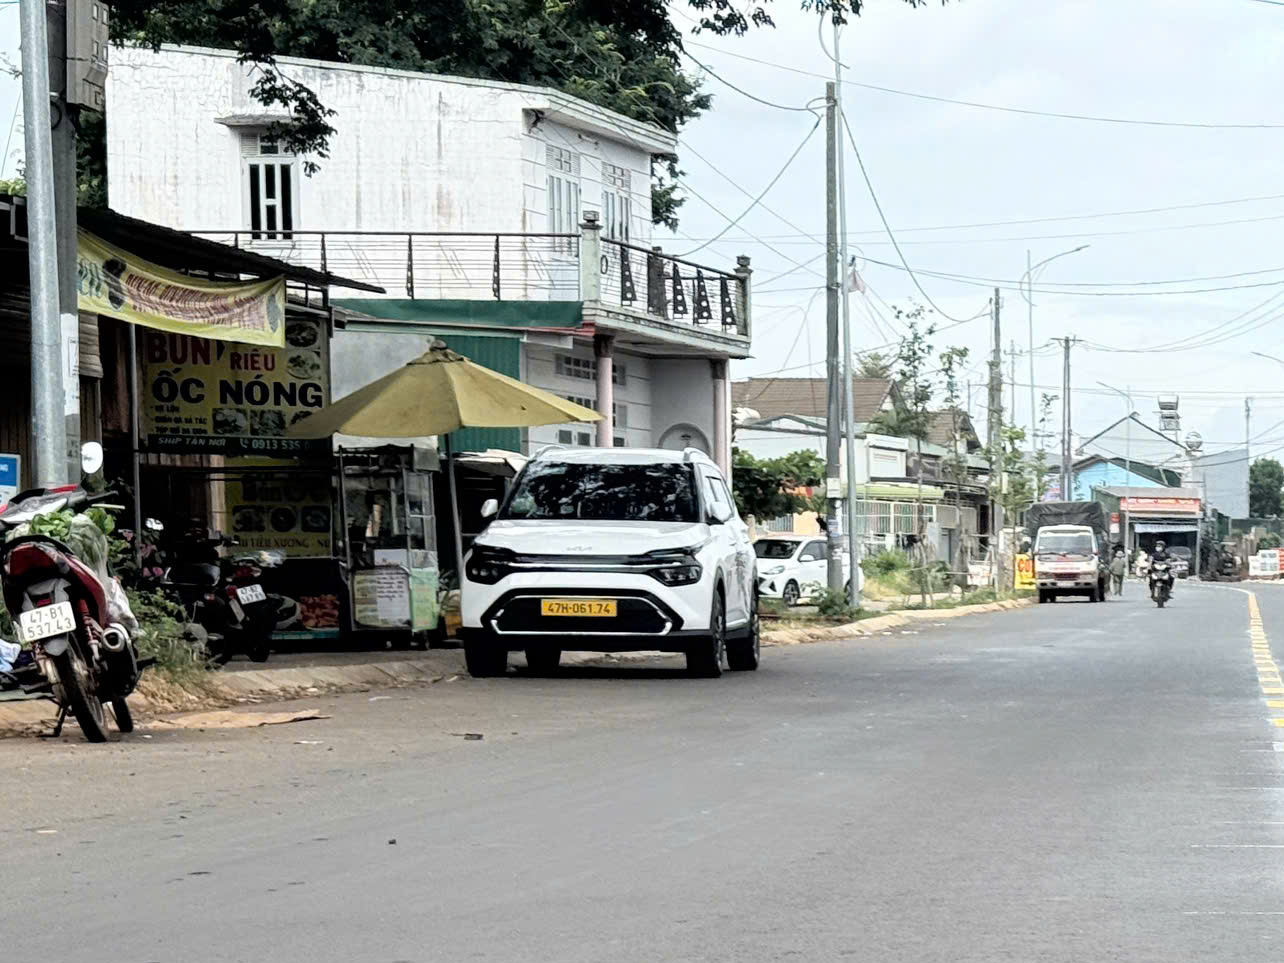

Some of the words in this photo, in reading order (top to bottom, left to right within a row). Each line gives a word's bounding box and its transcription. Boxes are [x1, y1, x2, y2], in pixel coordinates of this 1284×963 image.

[229, 348, 276, 371] RIÊU
[152, 367, 206, 403] ỐC
[219, 374, 323, 408] NÓNG
[158, 437, 182, 445] SHIP
[252, 439, 278, 450] 0913
[30, 605, 64, 623] 47-B1
[547, 602, 611, 614] 47H-061.74
[27, 617, 72, 639] 537.43
